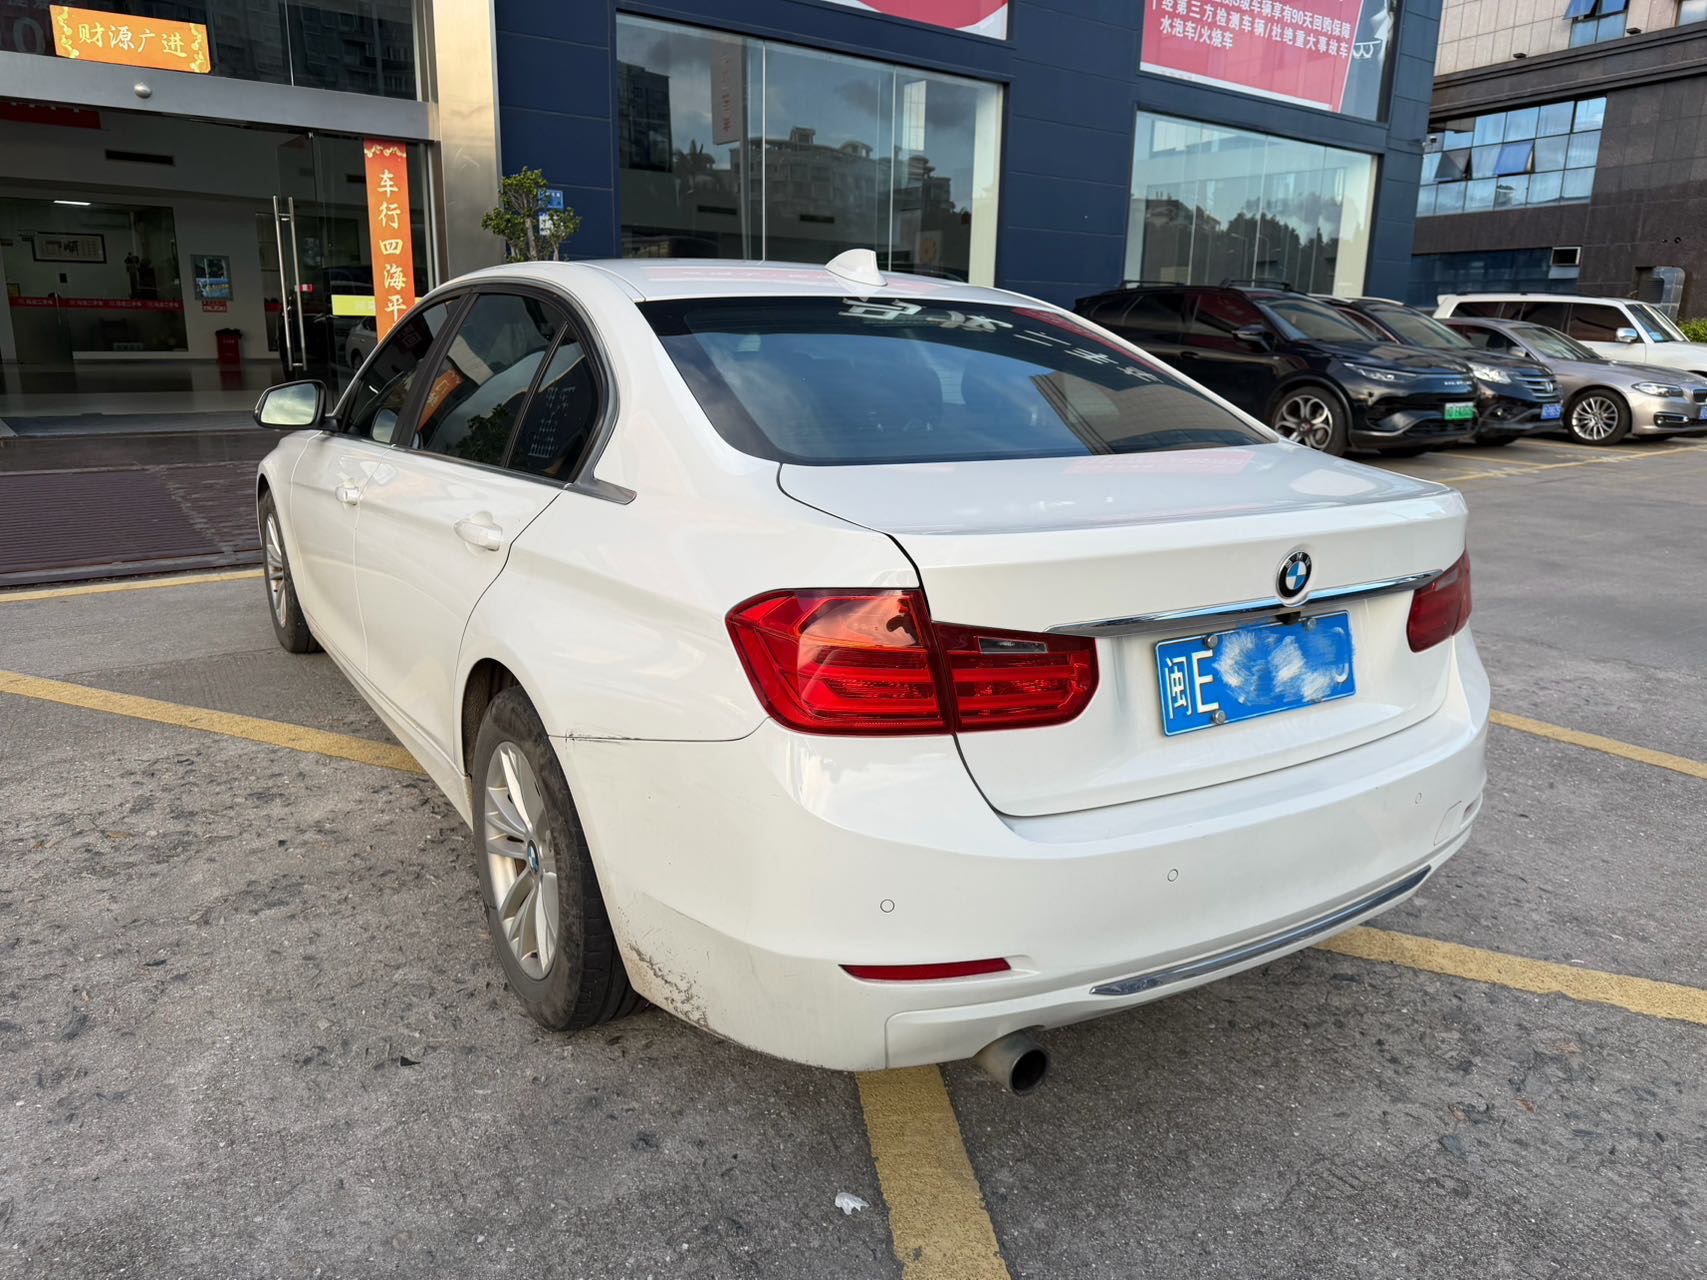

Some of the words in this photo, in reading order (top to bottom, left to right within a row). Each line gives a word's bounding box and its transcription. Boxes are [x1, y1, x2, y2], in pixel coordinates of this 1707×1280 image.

[78, 22, 188, 57] 财源广进
[1160, 15, 1234, 49] 水泡车/火烧车
[377, 169, 407, 330] 车行四海平
